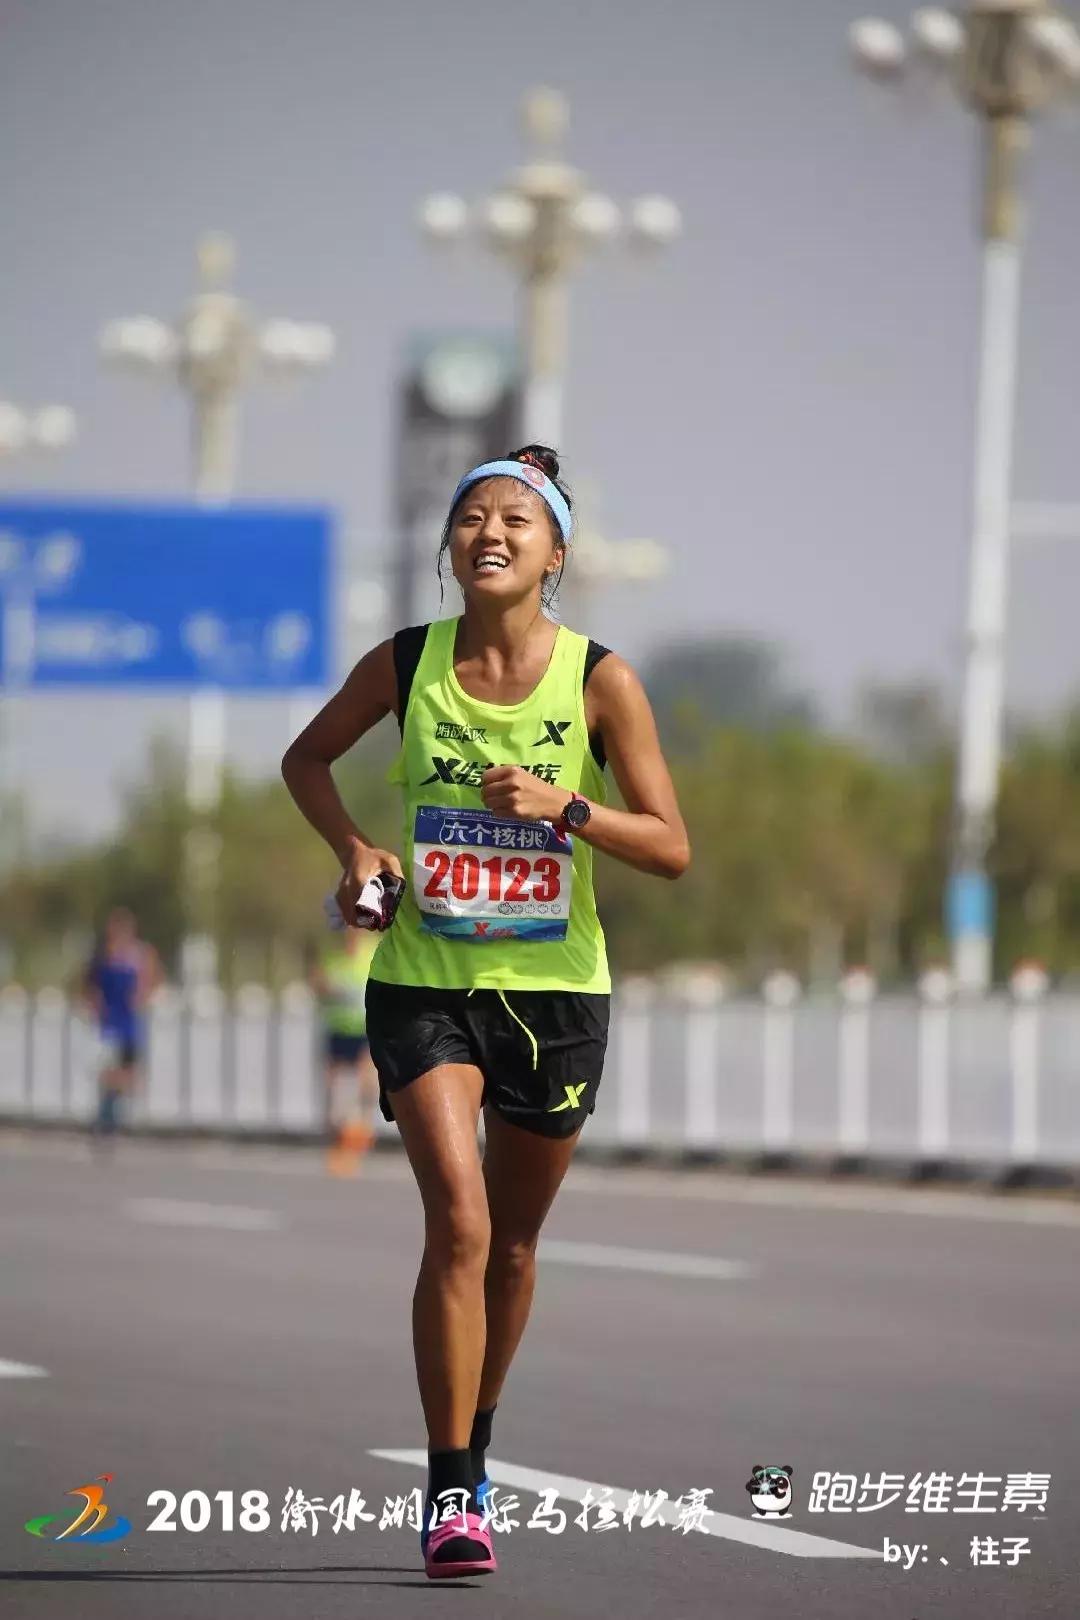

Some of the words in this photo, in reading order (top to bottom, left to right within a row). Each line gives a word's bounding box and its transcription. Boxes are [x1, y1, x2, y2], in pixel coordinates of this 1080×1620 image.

[444, 821, 544, 848] 六个核桃
[423, 850, 561, 902] 20123
